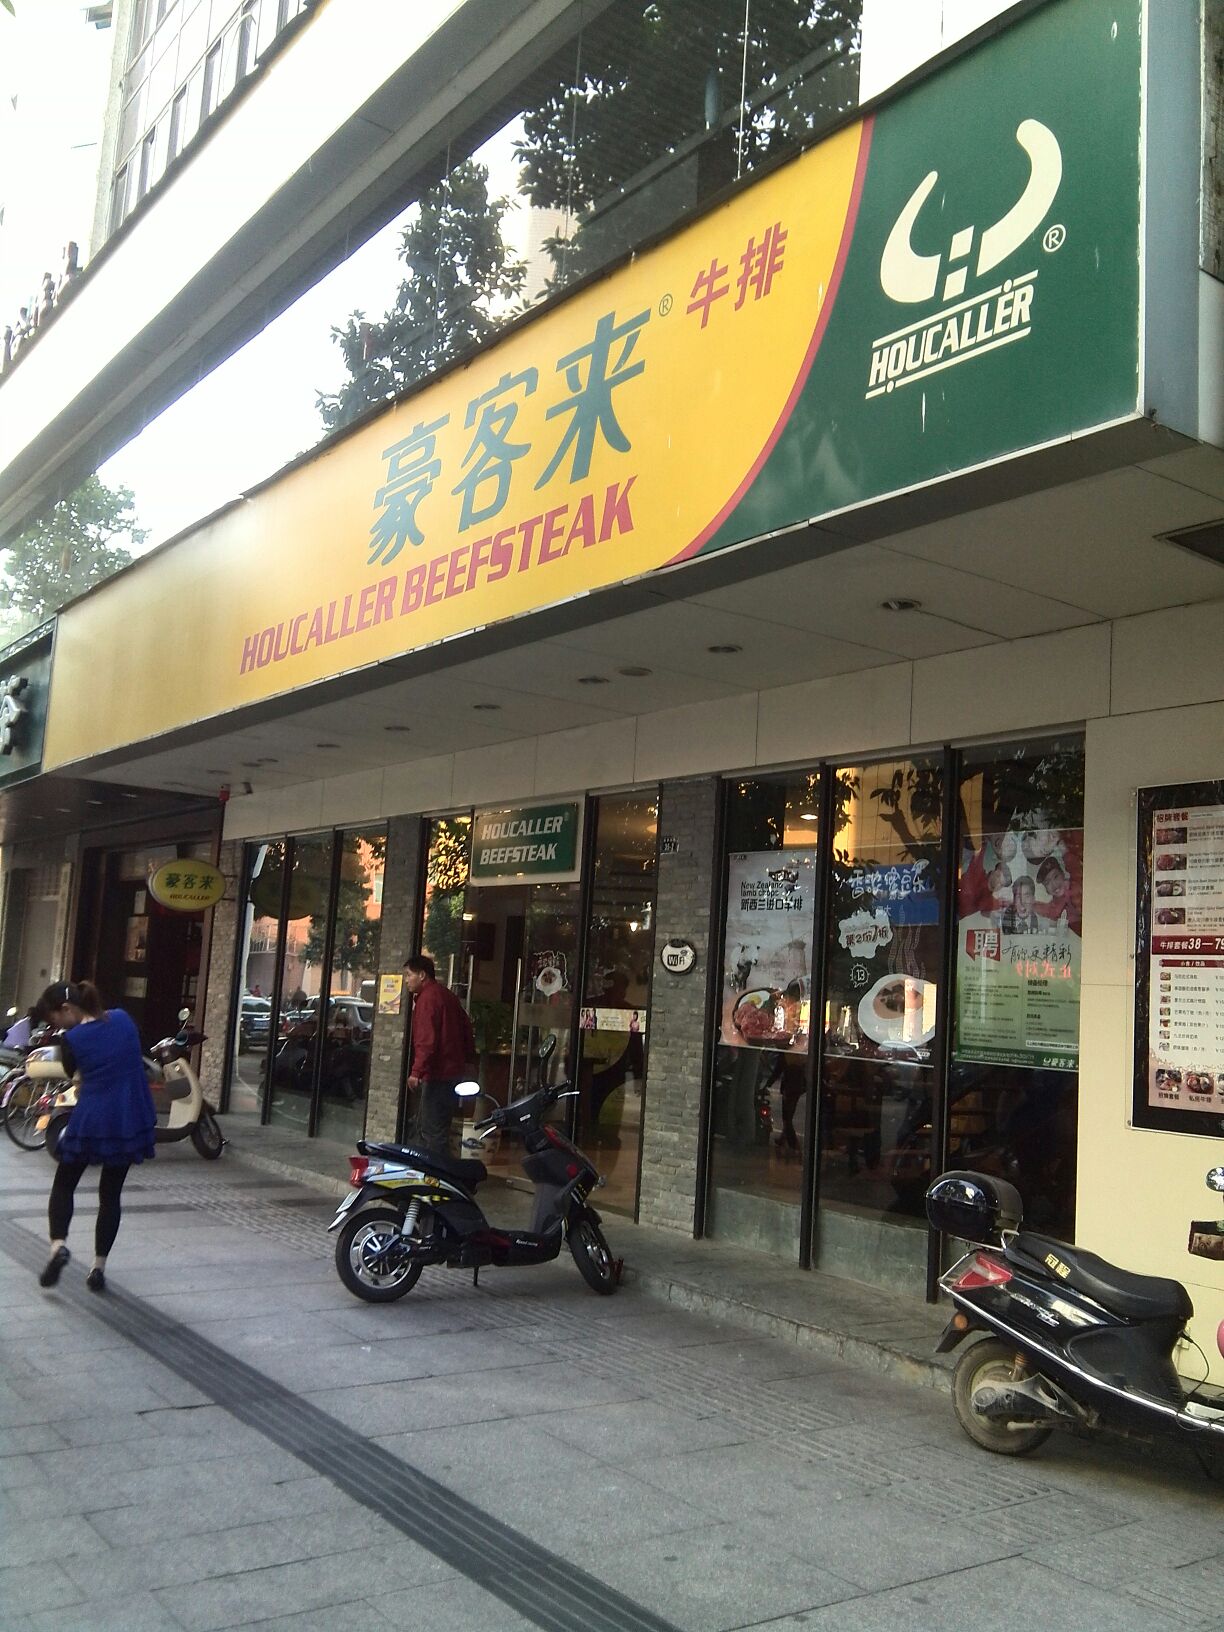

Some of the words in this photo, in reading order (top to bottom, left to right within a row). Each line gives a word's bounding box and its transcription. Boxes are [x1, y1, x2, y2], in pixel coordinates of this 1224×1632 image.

[686, 221, 789, 330] 牛排
[868, 284, 1035, 388] HOUCALLER
[367, 308, 651, 566] 豪客来
[240, 575, 398, 676] HOUCALLER
[400, 475, 638, 616] BEEFSTEAK
[482, 815, 564, 841] HOUCALLER
[480, 842, 558, 866] BEEFSTEAK
[165, 872, 215, 890] 豪客来
[740, 889, 757, 897] lamb
[741, 881, 755, 889] New
[974, 930, 998, 957] 聘
